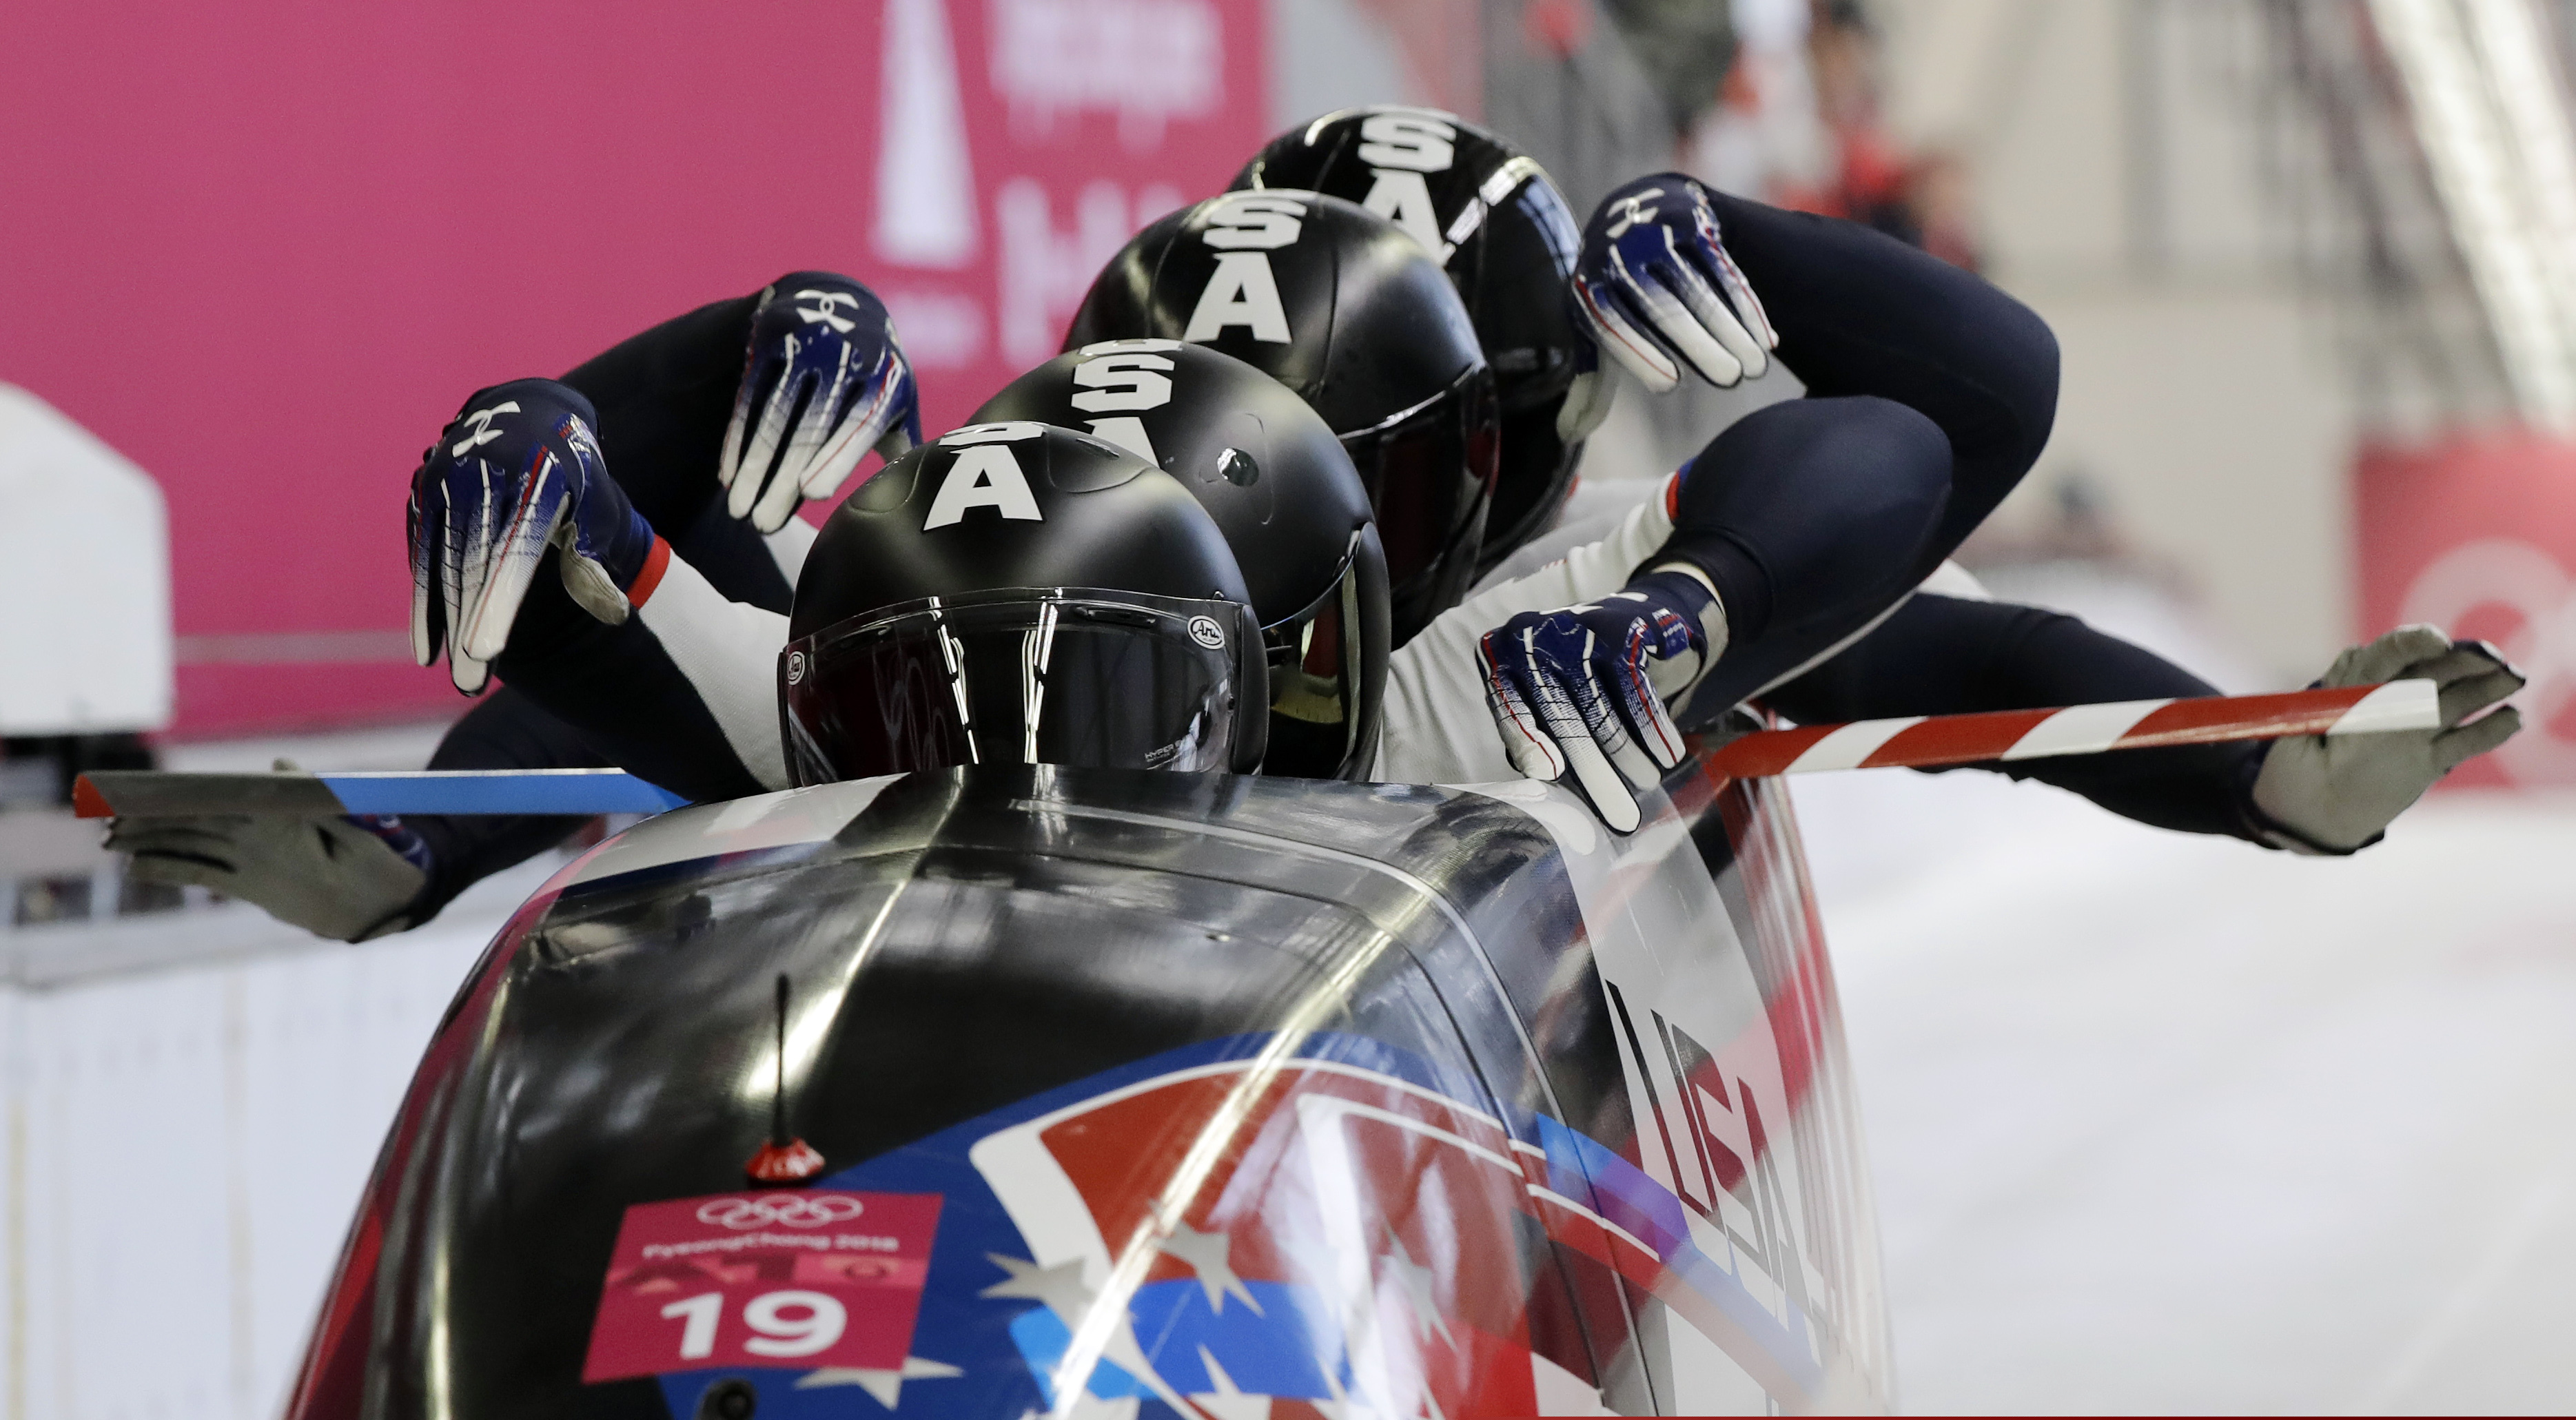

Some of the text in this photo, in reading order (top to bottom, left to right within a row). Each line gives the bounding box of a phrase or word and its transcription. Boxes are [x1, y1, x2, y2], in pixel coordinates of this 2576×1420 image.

[1358, 105, 1456, 267] SA
[1183, 189, 1308, 344] SA
[1071, 338, 1183, 470] SA
[660, 1289, 848, 1361] 19
